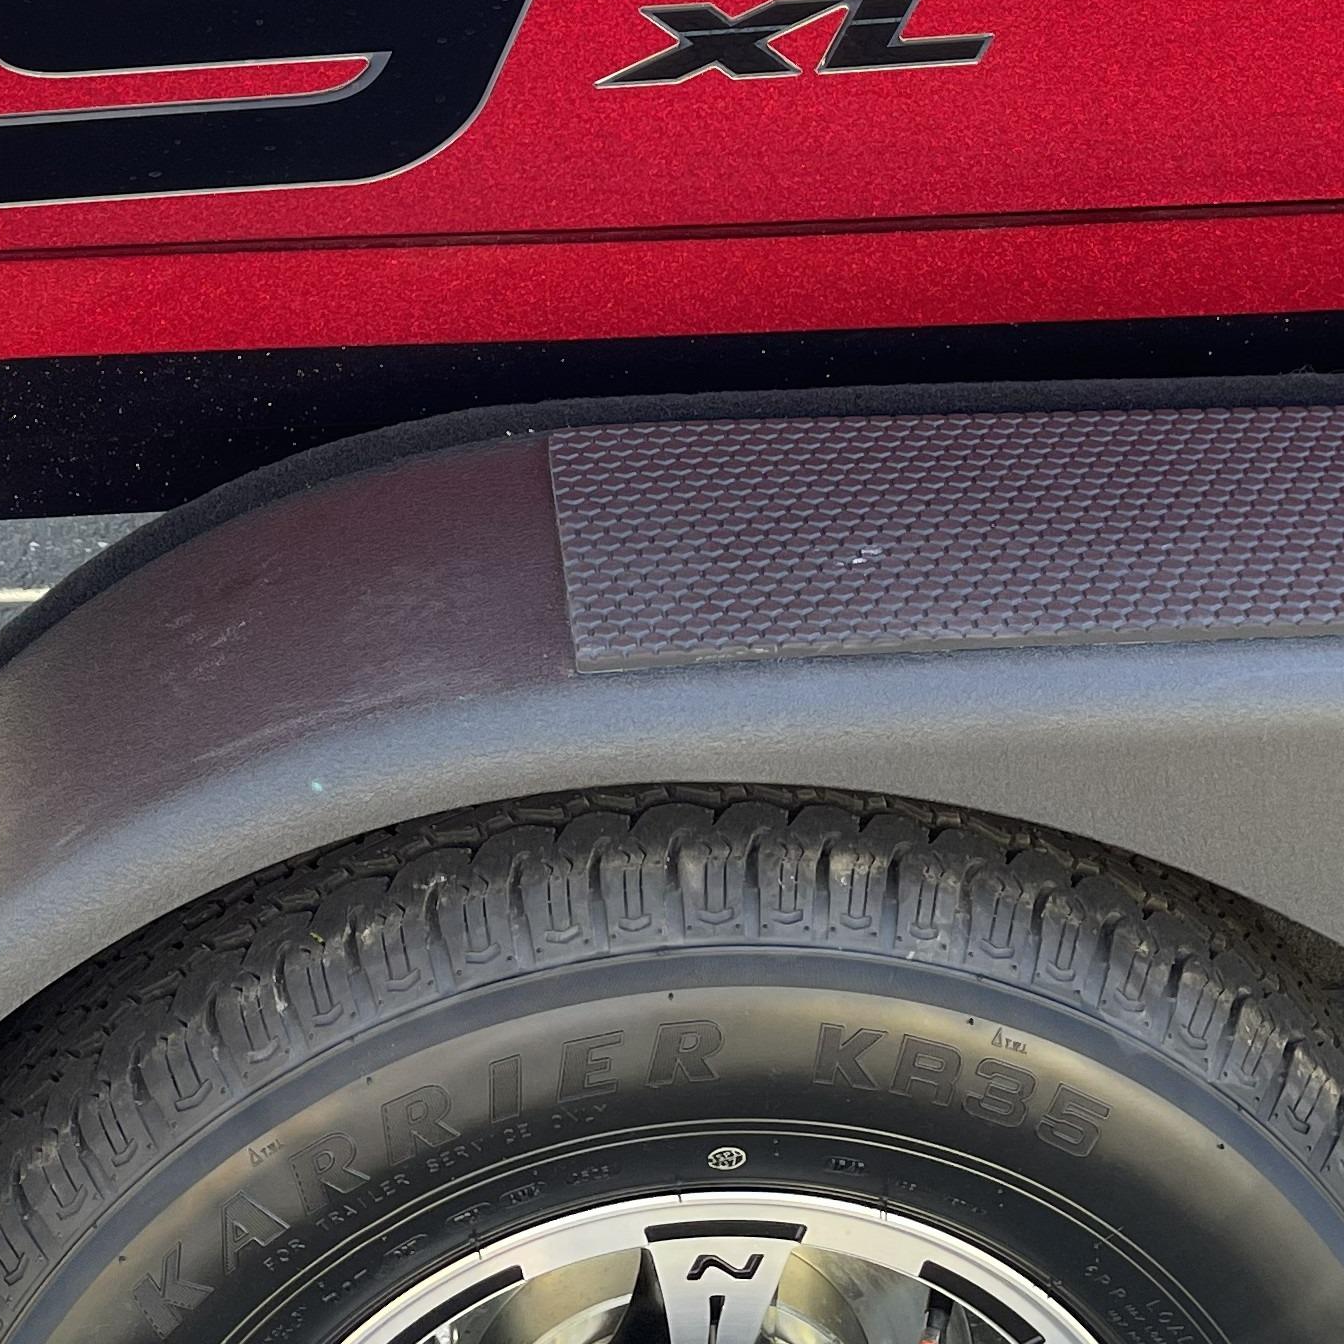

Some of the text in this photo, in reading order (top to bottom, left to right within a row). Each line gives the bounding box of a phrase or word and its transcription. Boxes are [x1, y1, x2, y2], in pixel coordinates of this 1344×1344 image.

[132, 1018, 1113, 1341] KARRIER KR35
[316, 1172, 411, 1233] TRAILER
